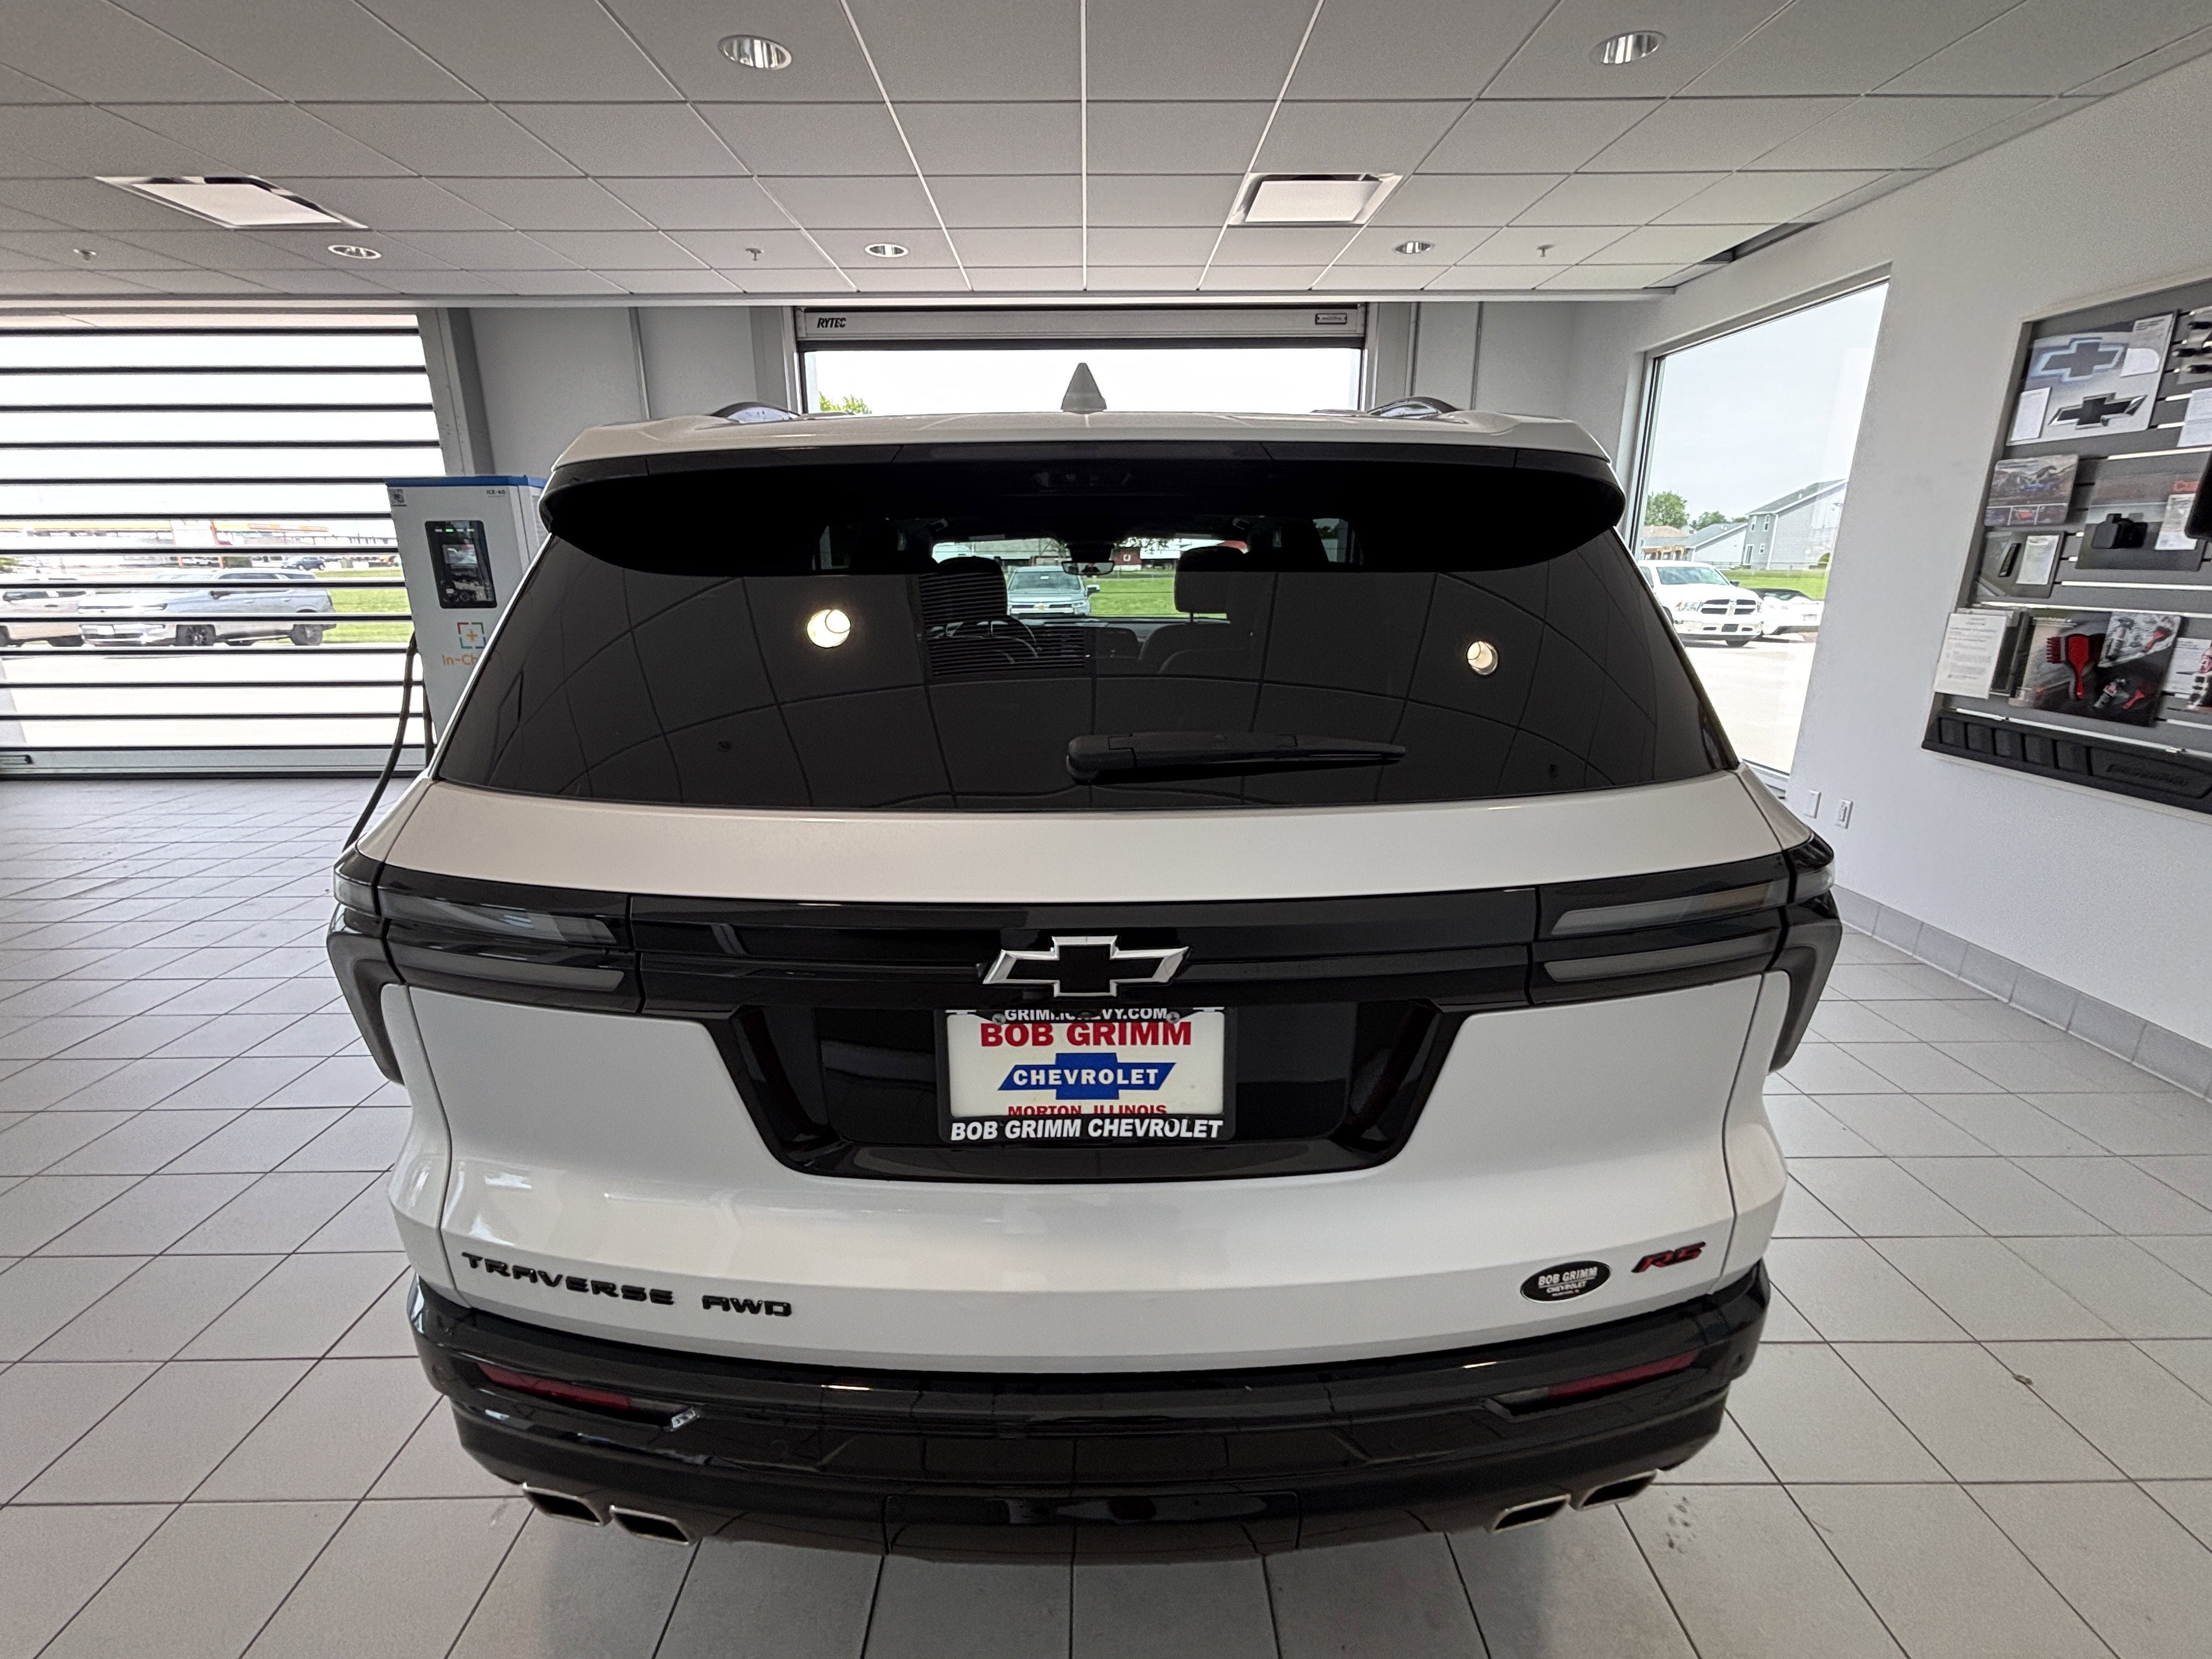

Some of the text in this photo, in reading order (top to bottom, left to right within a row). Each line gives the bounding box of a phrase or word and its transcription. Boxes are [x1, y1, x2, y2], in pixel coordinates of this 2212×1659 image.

[816, 317, 847, 328] RYTEC
[1005, 1008, 1167, 1021] GRIMMCVY.COM
[981, 1022, 1192, 1047] BOB GRIMM
[1013, 1069, 1158, 1086] CHEVROLET
[1008, 1105, 1082, 1115] MORTON
[951, 1119, 1223, 1141] BOB GRIMM CHEVROLET
[1631, 1241, 1706, 1273] RS
[461, 1251, 792, 1317] TRAVERSE AWD
[1538, 1266, 1598, 1286] BOB GRIMM
